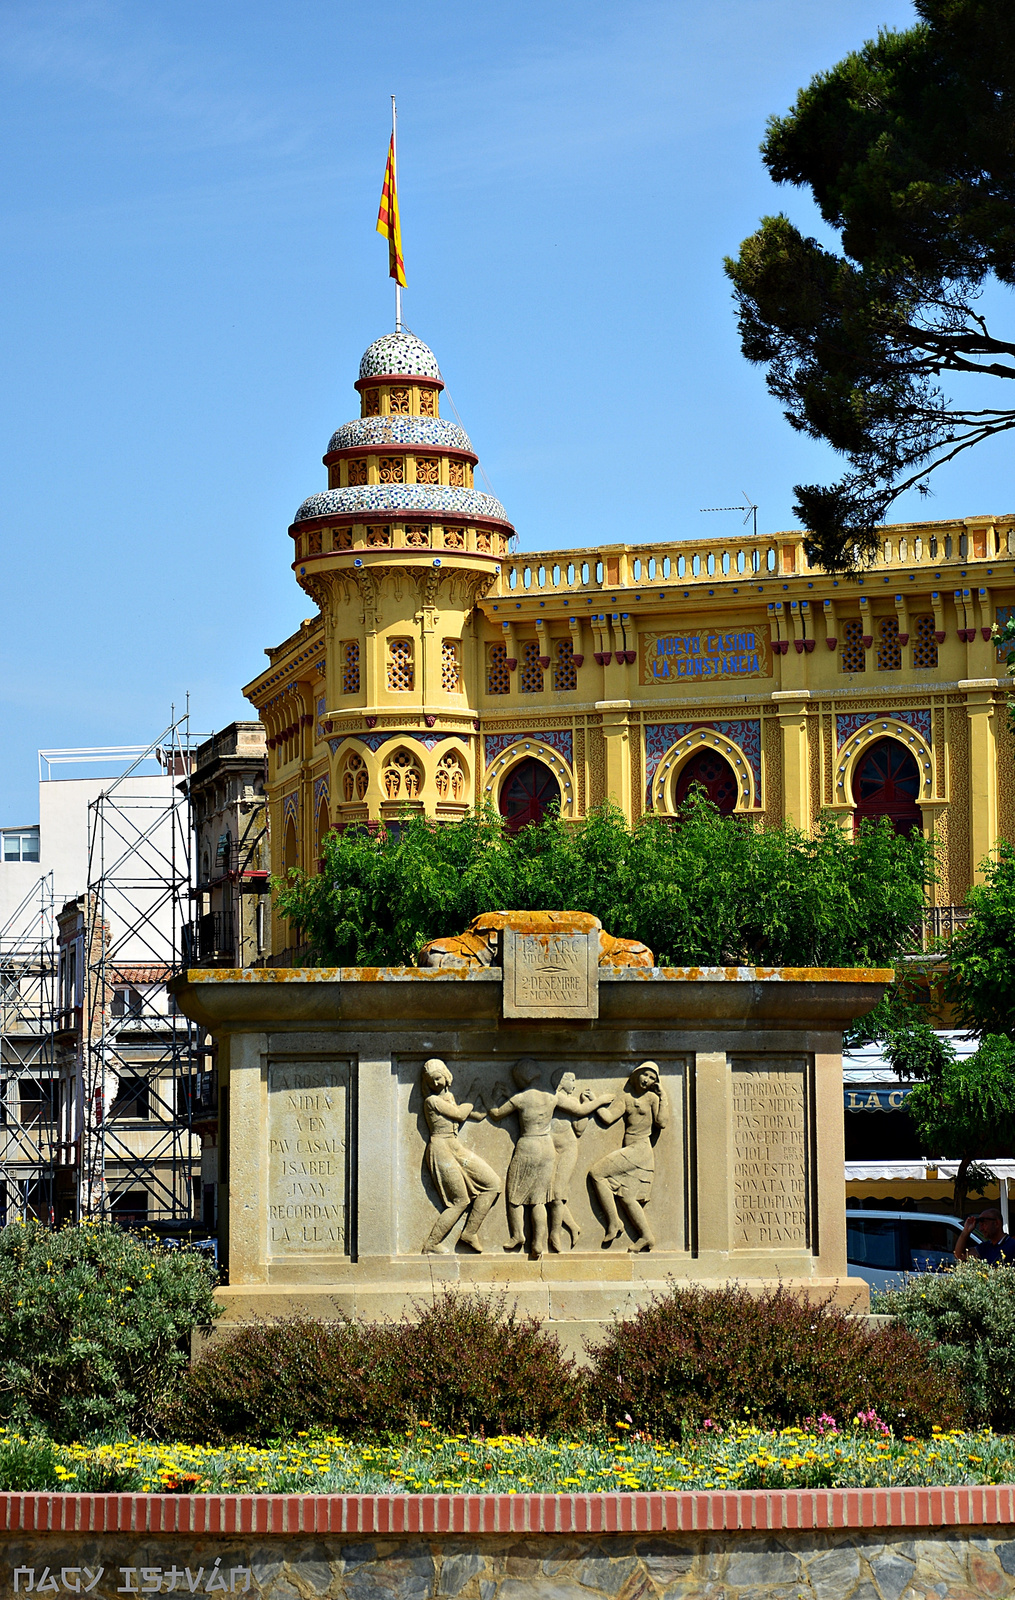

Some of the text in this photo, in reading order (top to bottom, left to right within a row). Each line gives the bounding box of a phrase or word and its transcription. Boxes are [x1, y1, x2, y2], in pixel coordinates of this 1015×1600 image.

[656, 632, 756, 656] NUEVO CASINO
[653, 655, 760, 678] LA CONSTANCIA
[270, 1072, 347, 1089] LA ROSADA
[768, 1098, 804, 1112] MEDES
[847, 1091, 883, 1108] LA
[293, 1117, 327, 1132] A EN
[790, 1131, 804, 1145] DE
[296, 1139, 347, 1154] CASALS
[734, 1179, 806, 1193] SONATA DE
[269, 1204, 346, 1220] RECORDANT
[734, 1211, 806, 1225] SONATA PER
[271, 1226, 346, 1242] LA LLAR
[740, 1229, 749, 1242] A
